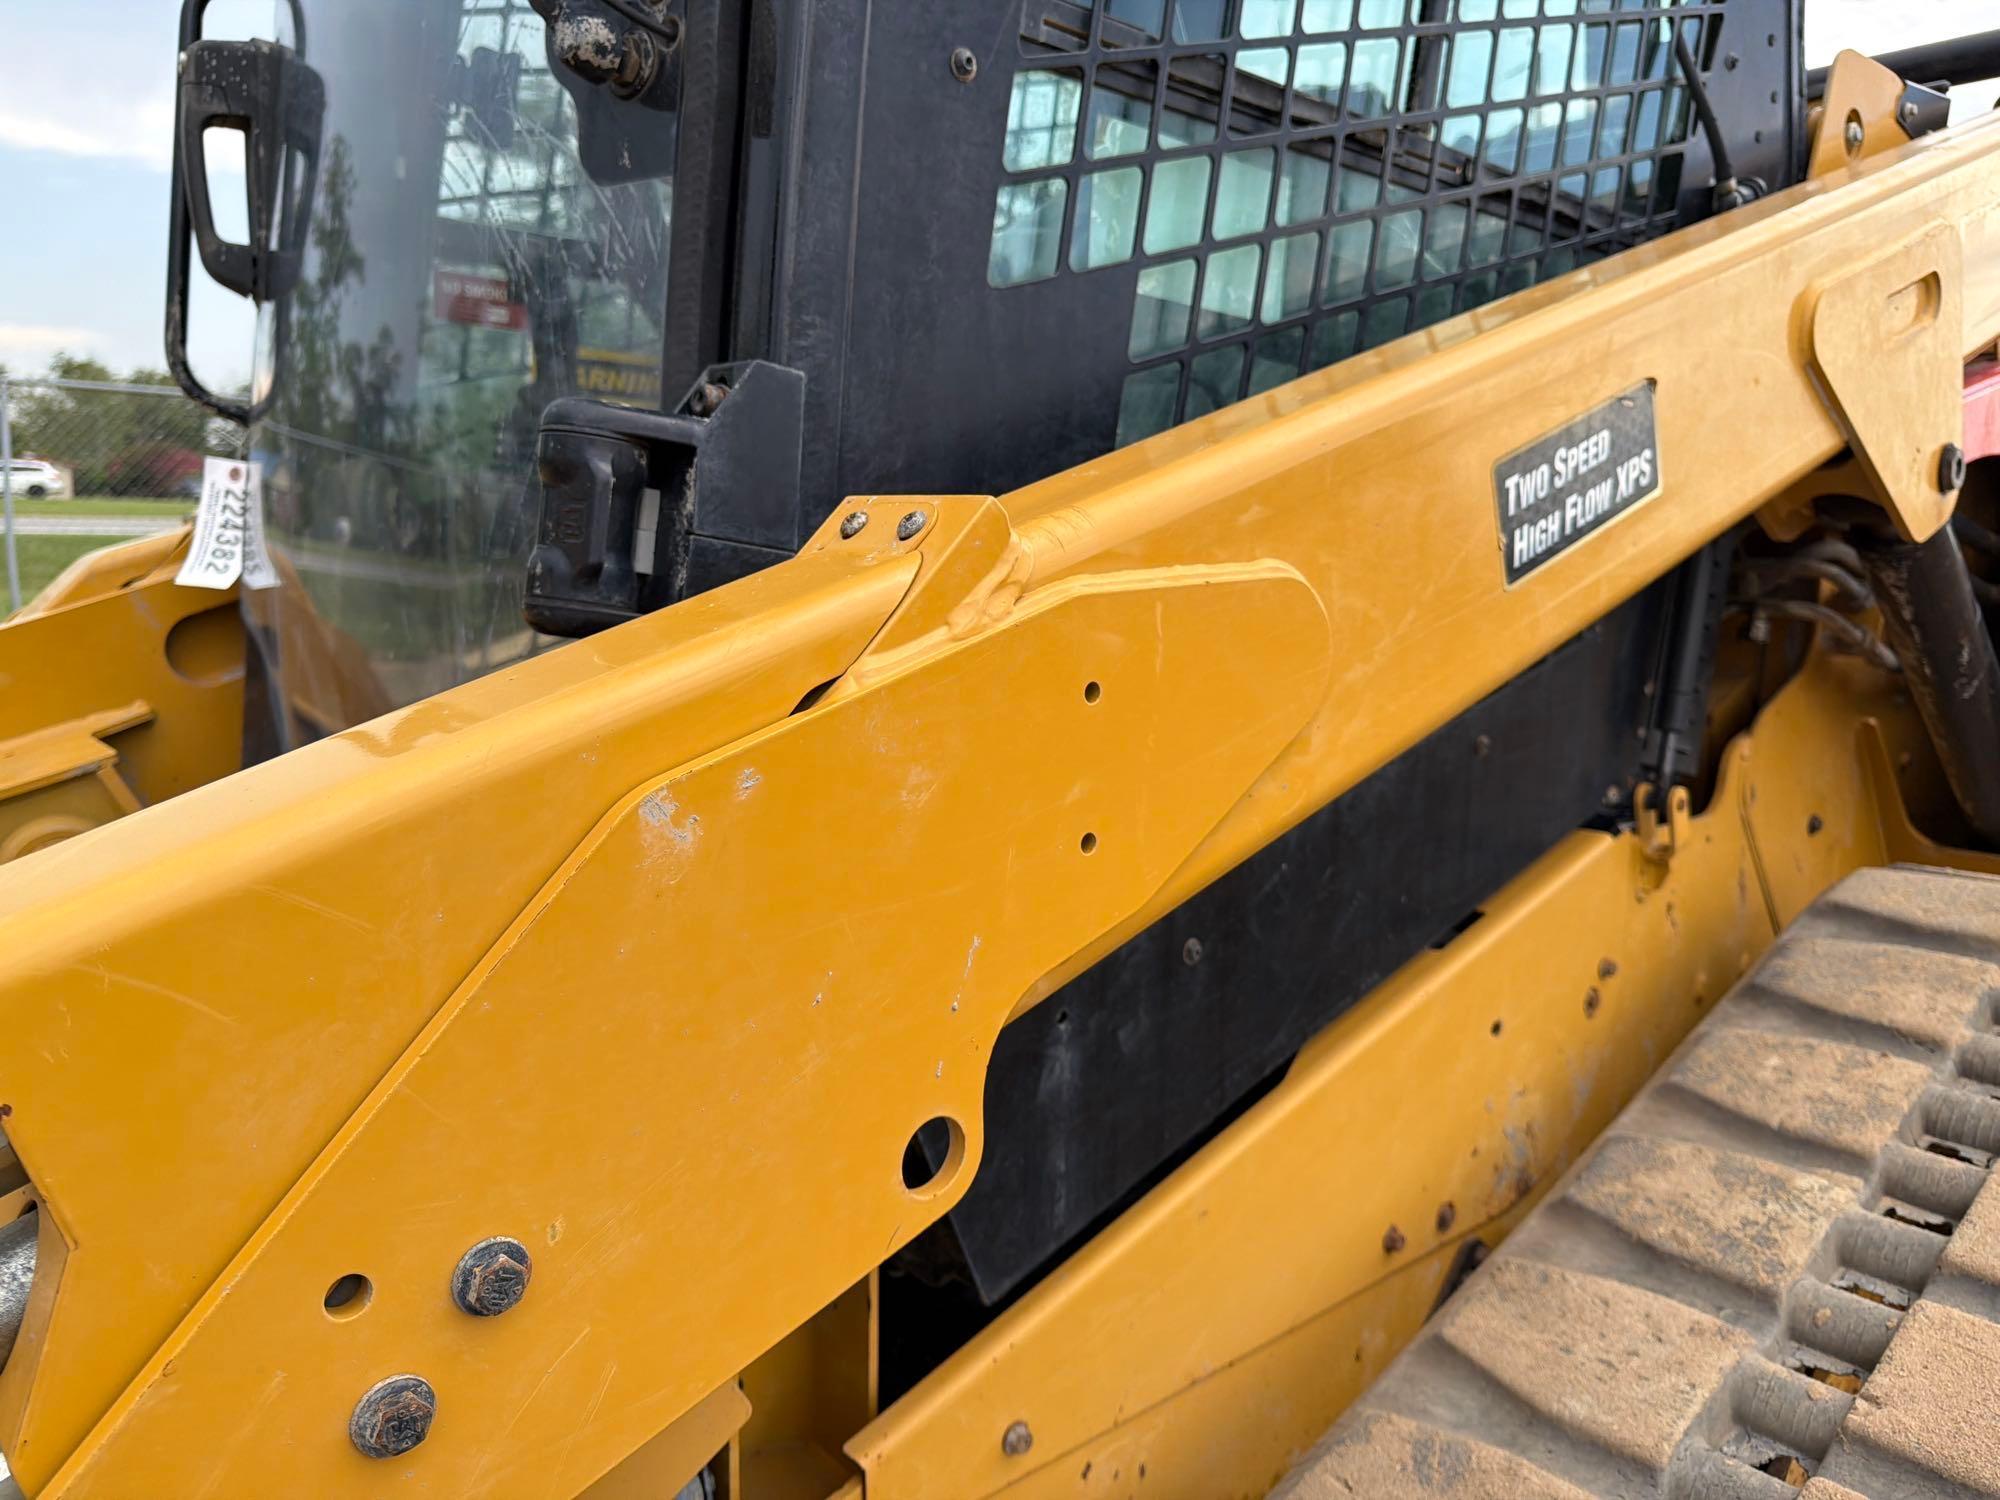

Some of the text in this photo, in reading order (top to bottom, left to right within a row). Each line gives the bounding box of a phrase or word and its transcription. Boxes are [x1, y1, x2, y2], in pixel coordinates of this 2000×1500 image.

[1505, 428, 1612, 517] TWO SPEED
[1512, 448, 1653, 568] HIGH FLOW XPS
[205, 488, 247, 575] 224382
